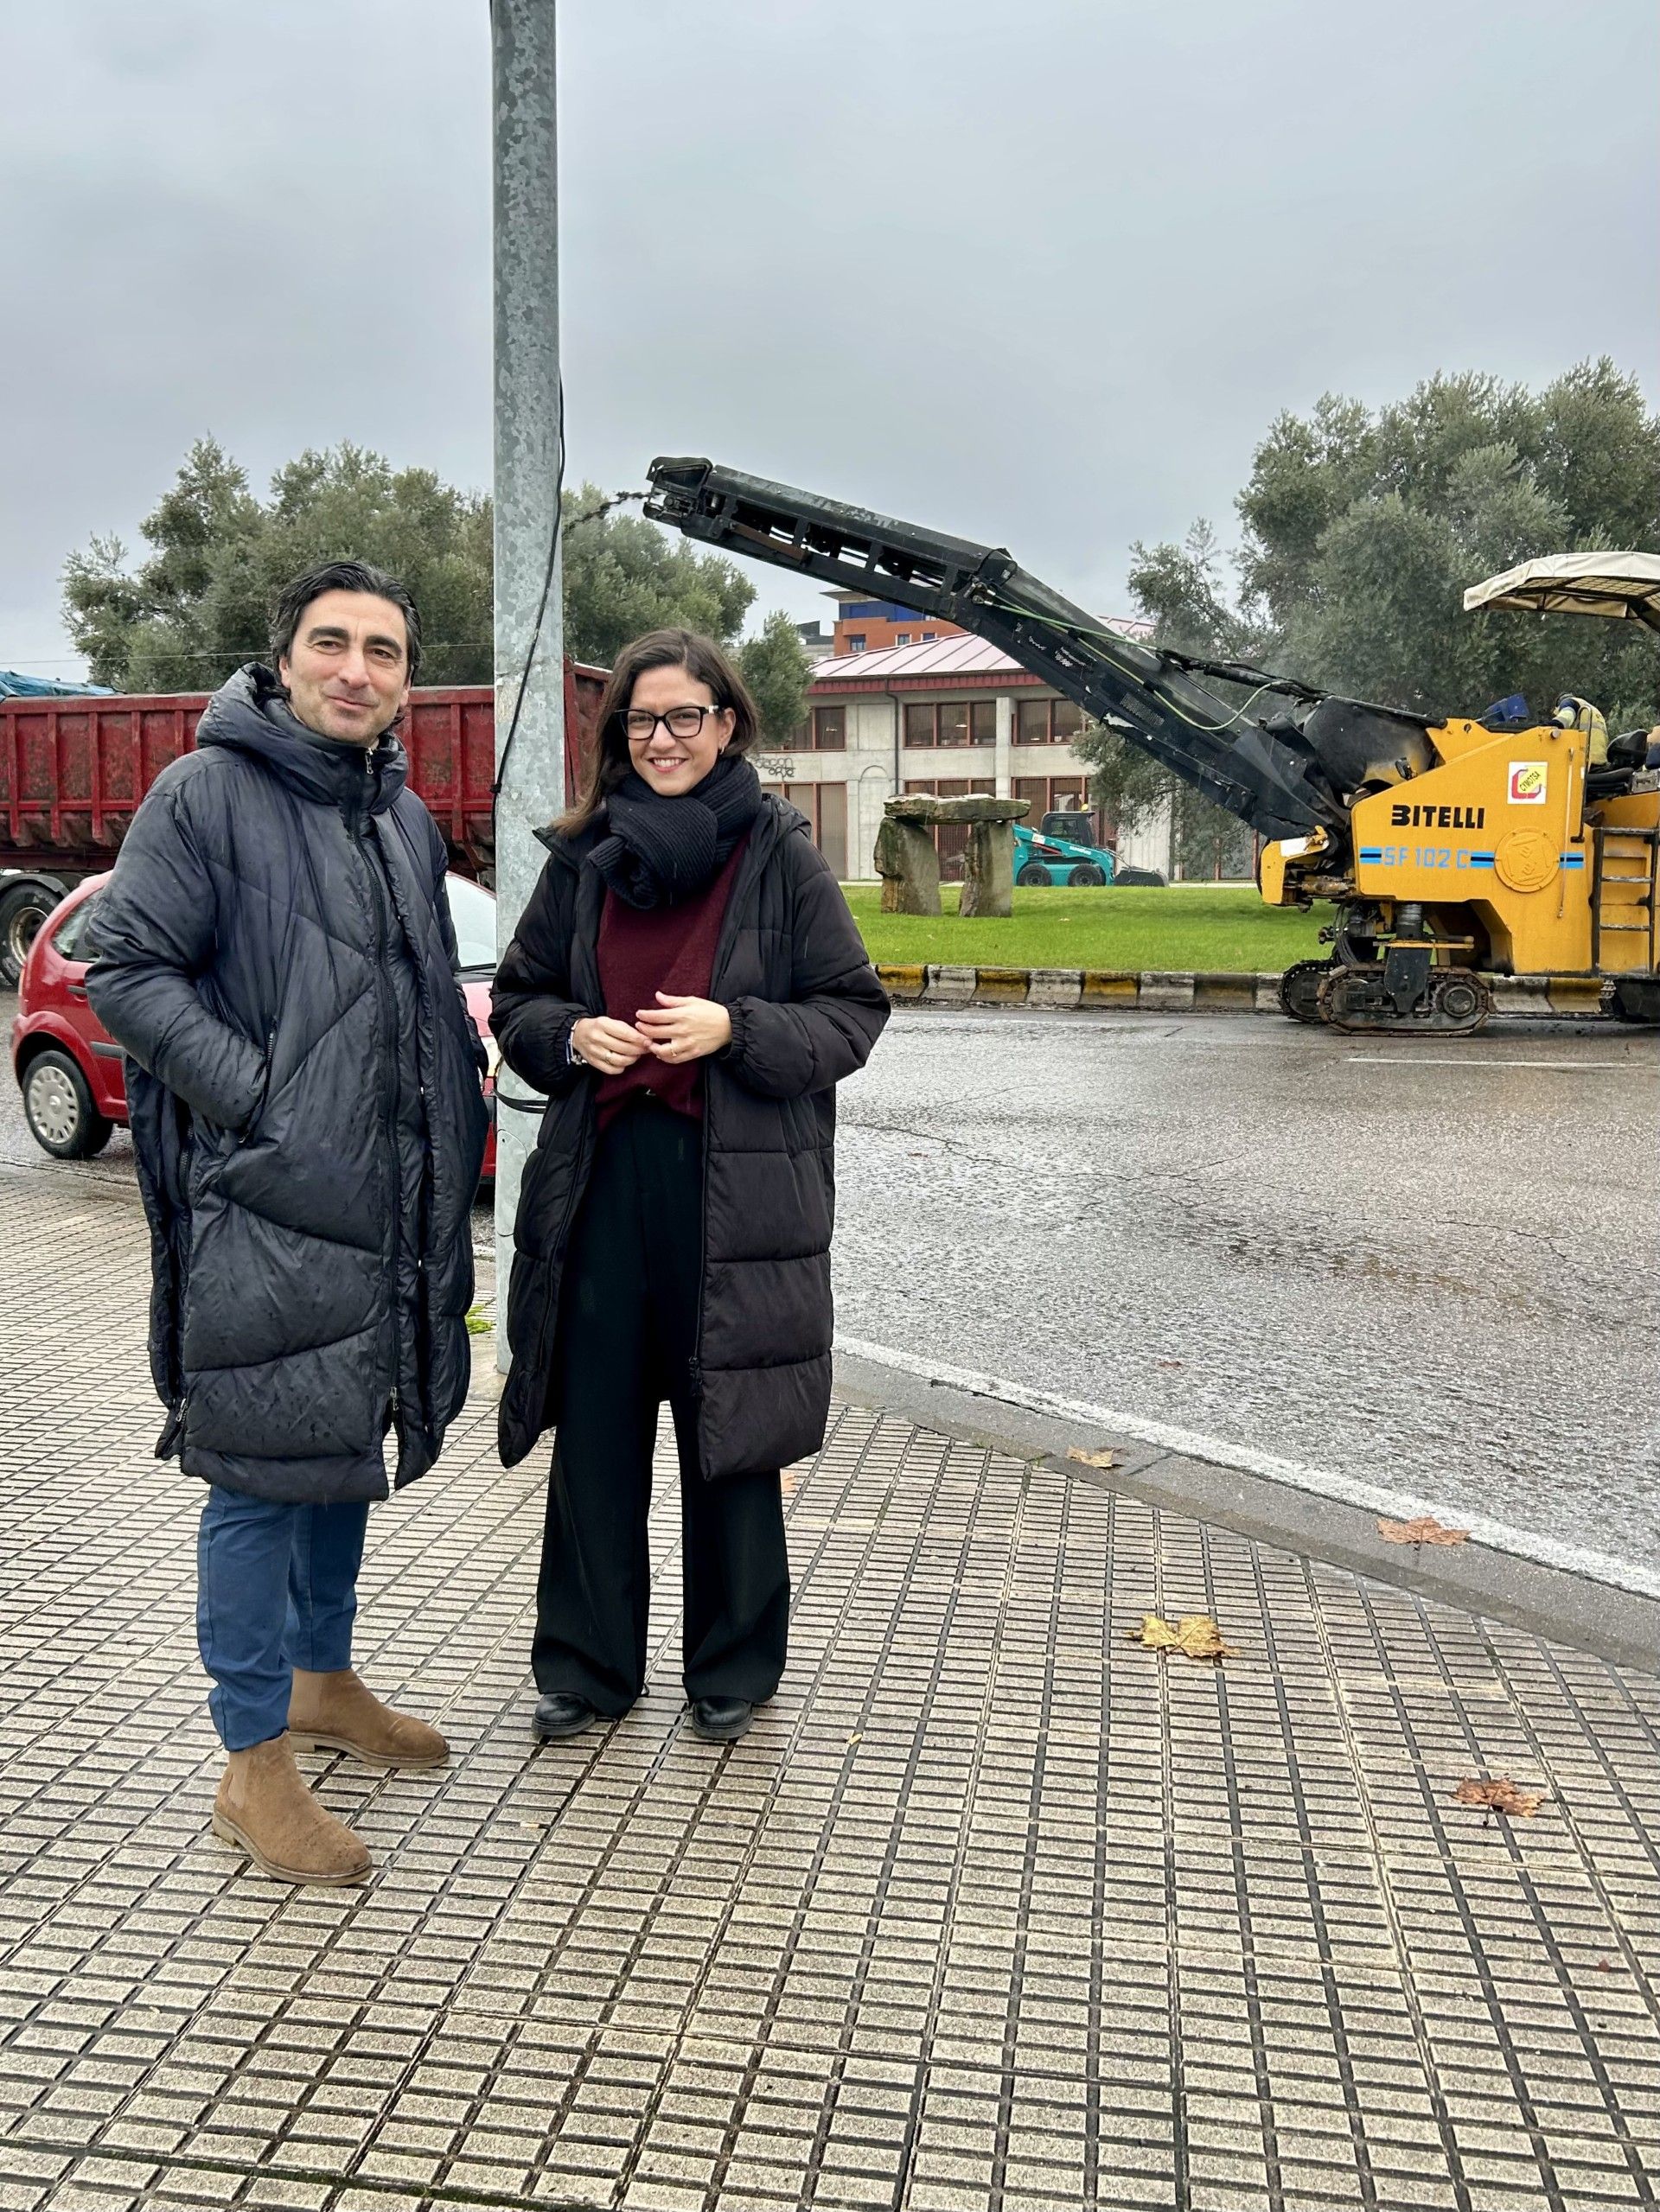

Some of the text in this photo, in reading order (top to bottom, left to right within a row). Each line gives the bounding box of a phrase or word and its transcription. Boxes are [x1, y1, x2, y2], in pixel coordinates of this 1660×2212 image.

[1391, 804, 1484, 829] BITELLI
[1384, 845, 1469, 869] SF 102 C
